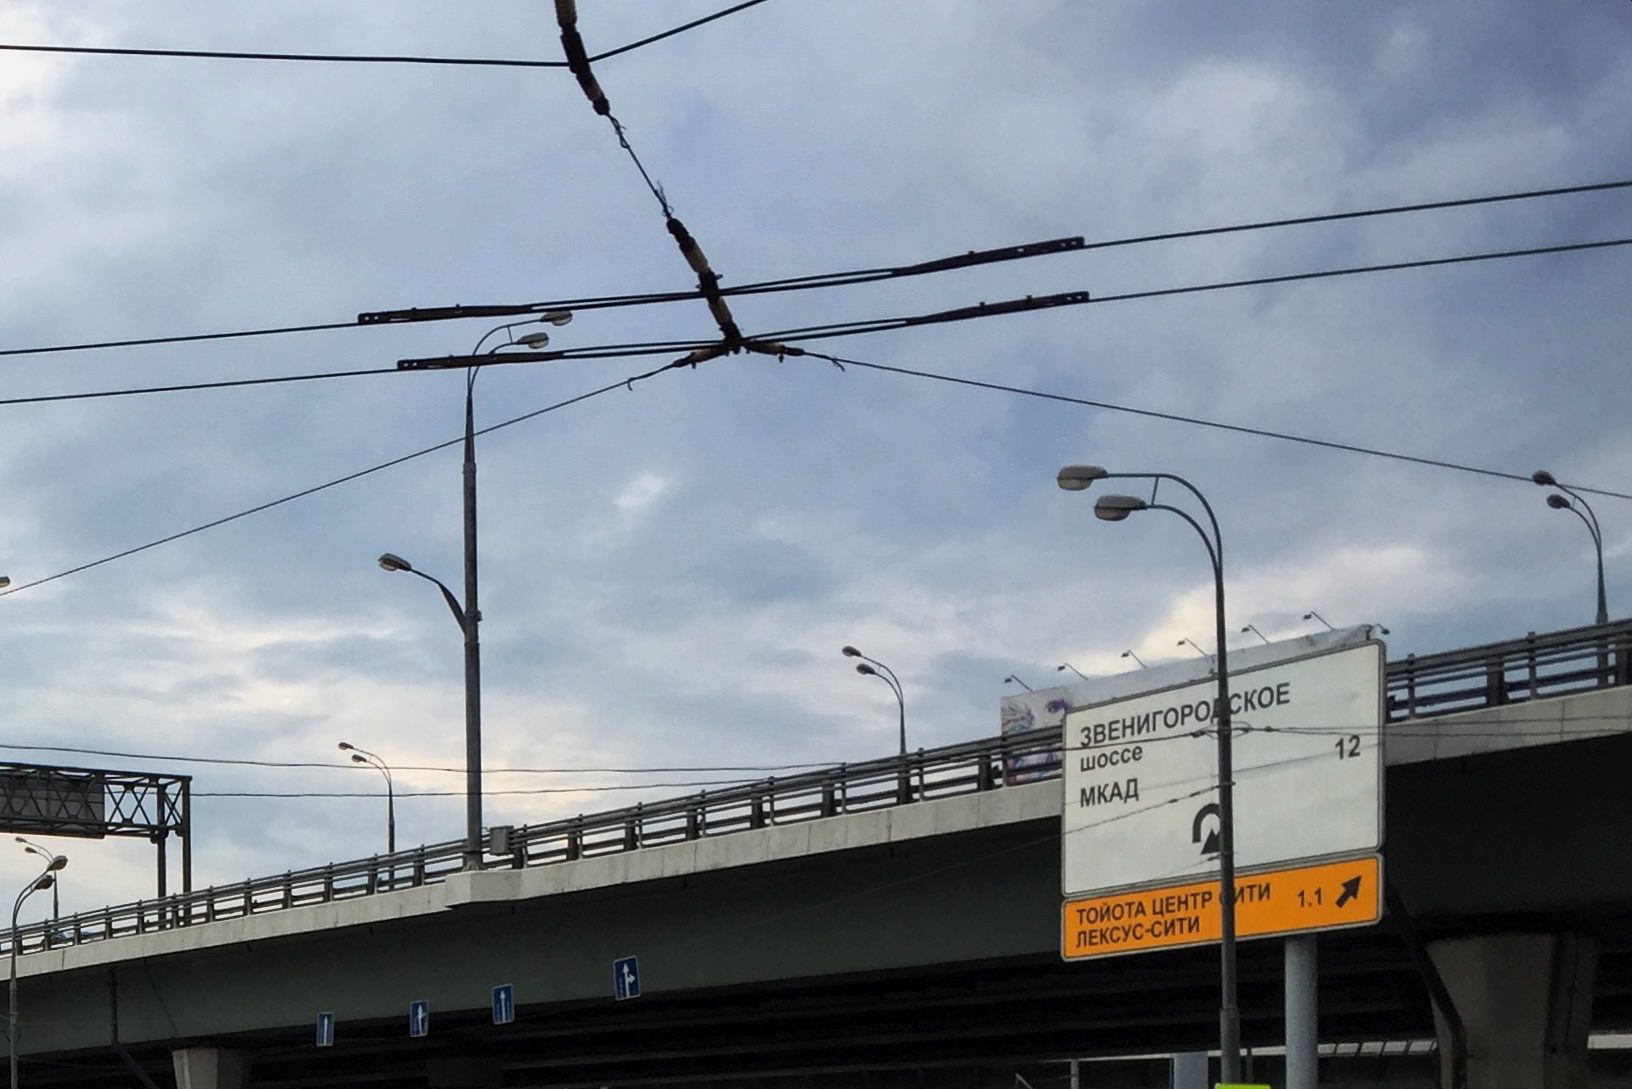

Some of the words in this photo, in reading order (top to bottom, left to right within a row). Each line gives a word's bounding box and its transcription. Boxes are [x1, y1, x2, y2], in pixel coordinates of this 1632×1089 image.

[1080, 746, 1143, 773] шоссе
[1335, 735, 1361, 760] 12
[1080, 778, 1140, 808] МКАД
[1076, 901, 1147, 926] ТОЙОТА
[1152, 890, 1213, 918] ЦЕНТР
[1219, 882, 1271, 905] ИТИ
[1298, 888, 1323, 908] 1.1
[1076, 916, 1201, 948] ЛЕКСУС-СИТИ
